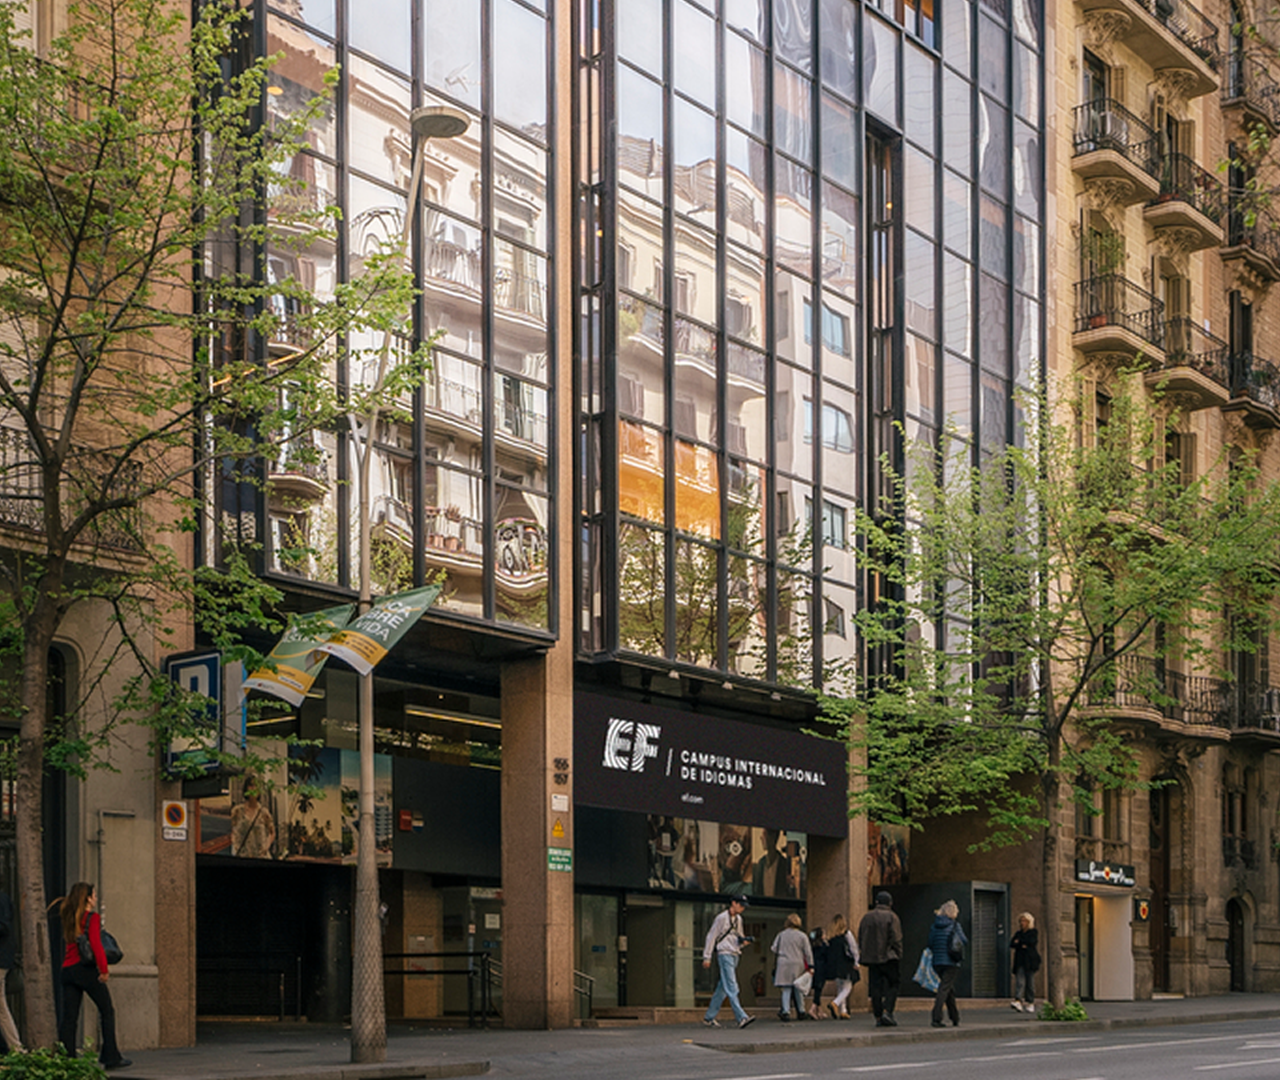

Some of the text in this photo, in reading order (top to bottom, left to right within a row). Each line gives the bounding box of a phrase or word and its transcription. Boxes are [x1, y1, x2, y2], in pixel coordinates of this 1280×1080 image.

[356, 619, 390, 642] VIDA
[602, 717, 662, 773] EF
[680, 749, 827, 787] CAMPUS INTERNACIONAL
[680, 765, 754, 790] DE IDIOMAS
